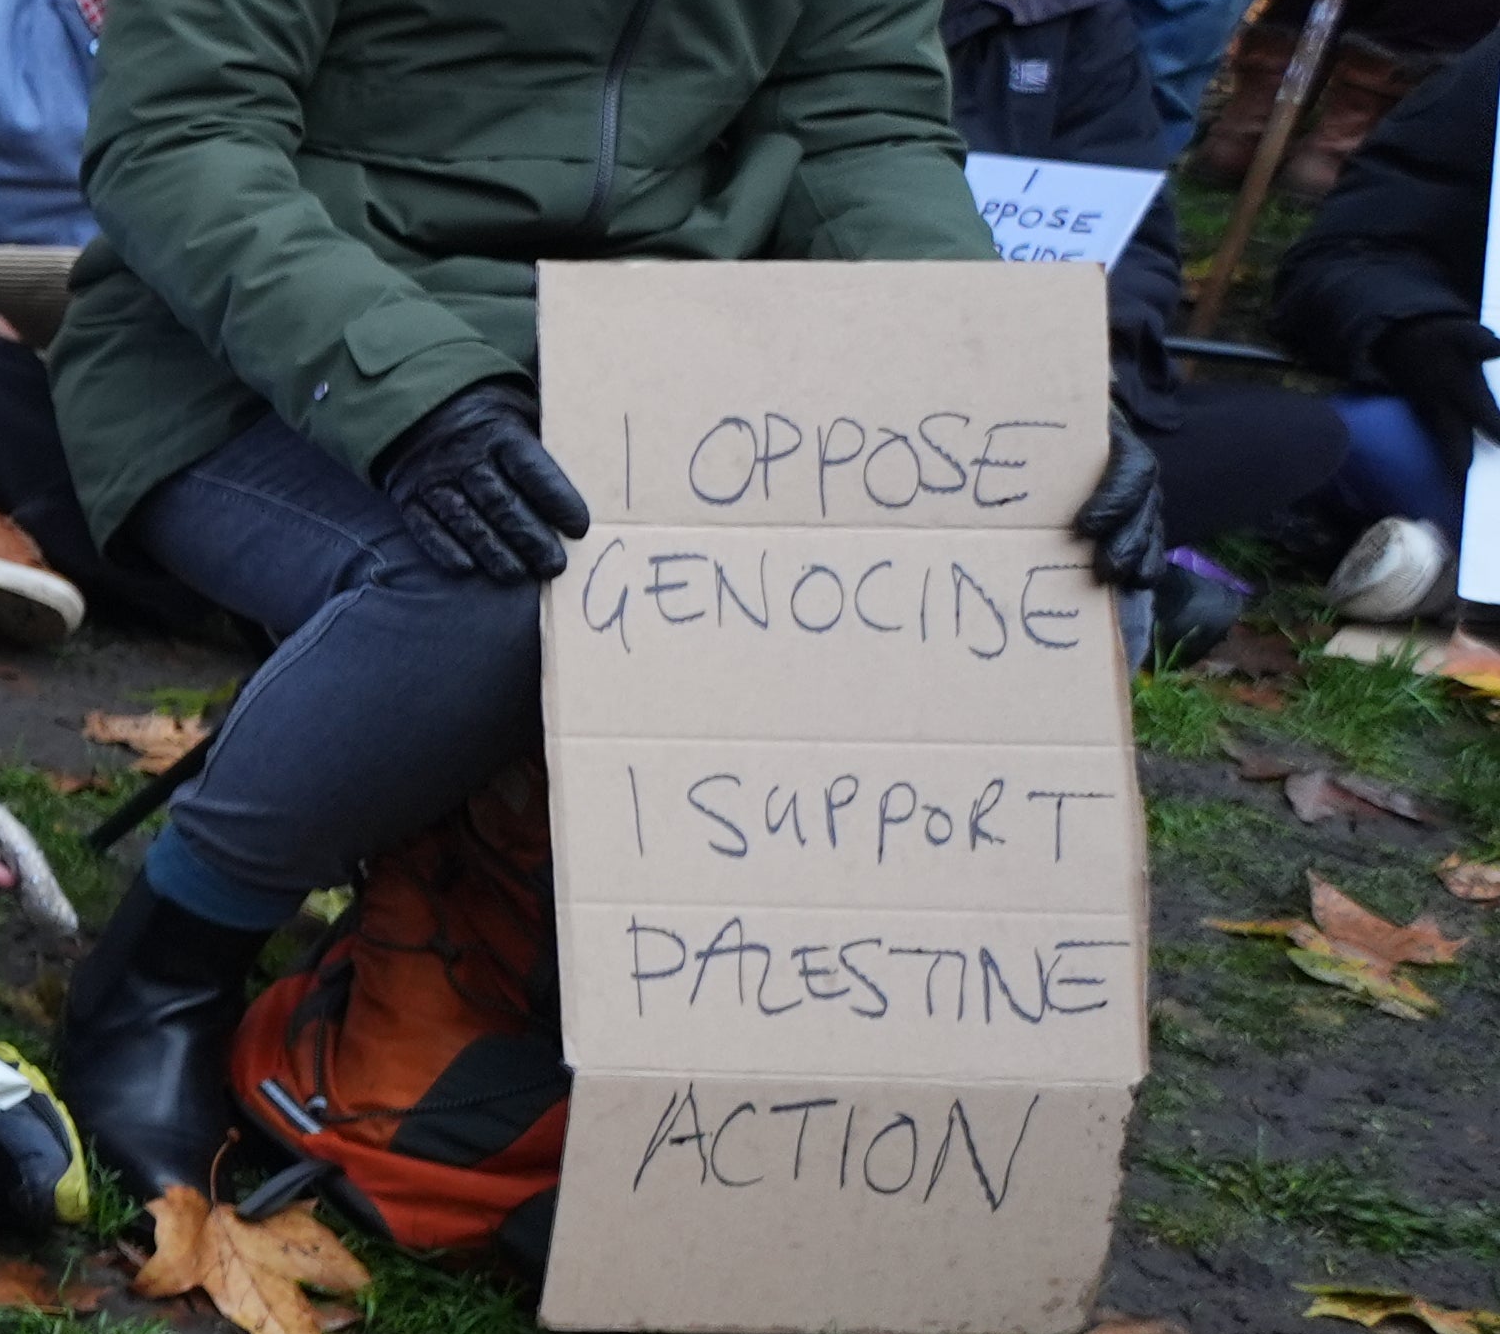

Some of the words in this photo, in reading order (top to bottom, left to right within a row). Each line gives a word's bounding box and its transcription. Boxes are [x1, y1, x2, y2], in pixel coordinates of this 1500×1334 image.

[980, 200, 1103, 234] PPOSE
[1022, 167, 1040, 194] I
[994, 242, 1085, 261] CIDE
[623, 412, 631, 511] I
[688, 411, 1068, 519] OPPOSE
[582, 538, 1082, 660] GENOCIDE
[627, 764, 644, 858] I
[686, 772, 1116, 865] SUPPORT
[625, 914, 1131, 1026] PALESTINE
[632, 1081, 1041, 1214] ACTION
